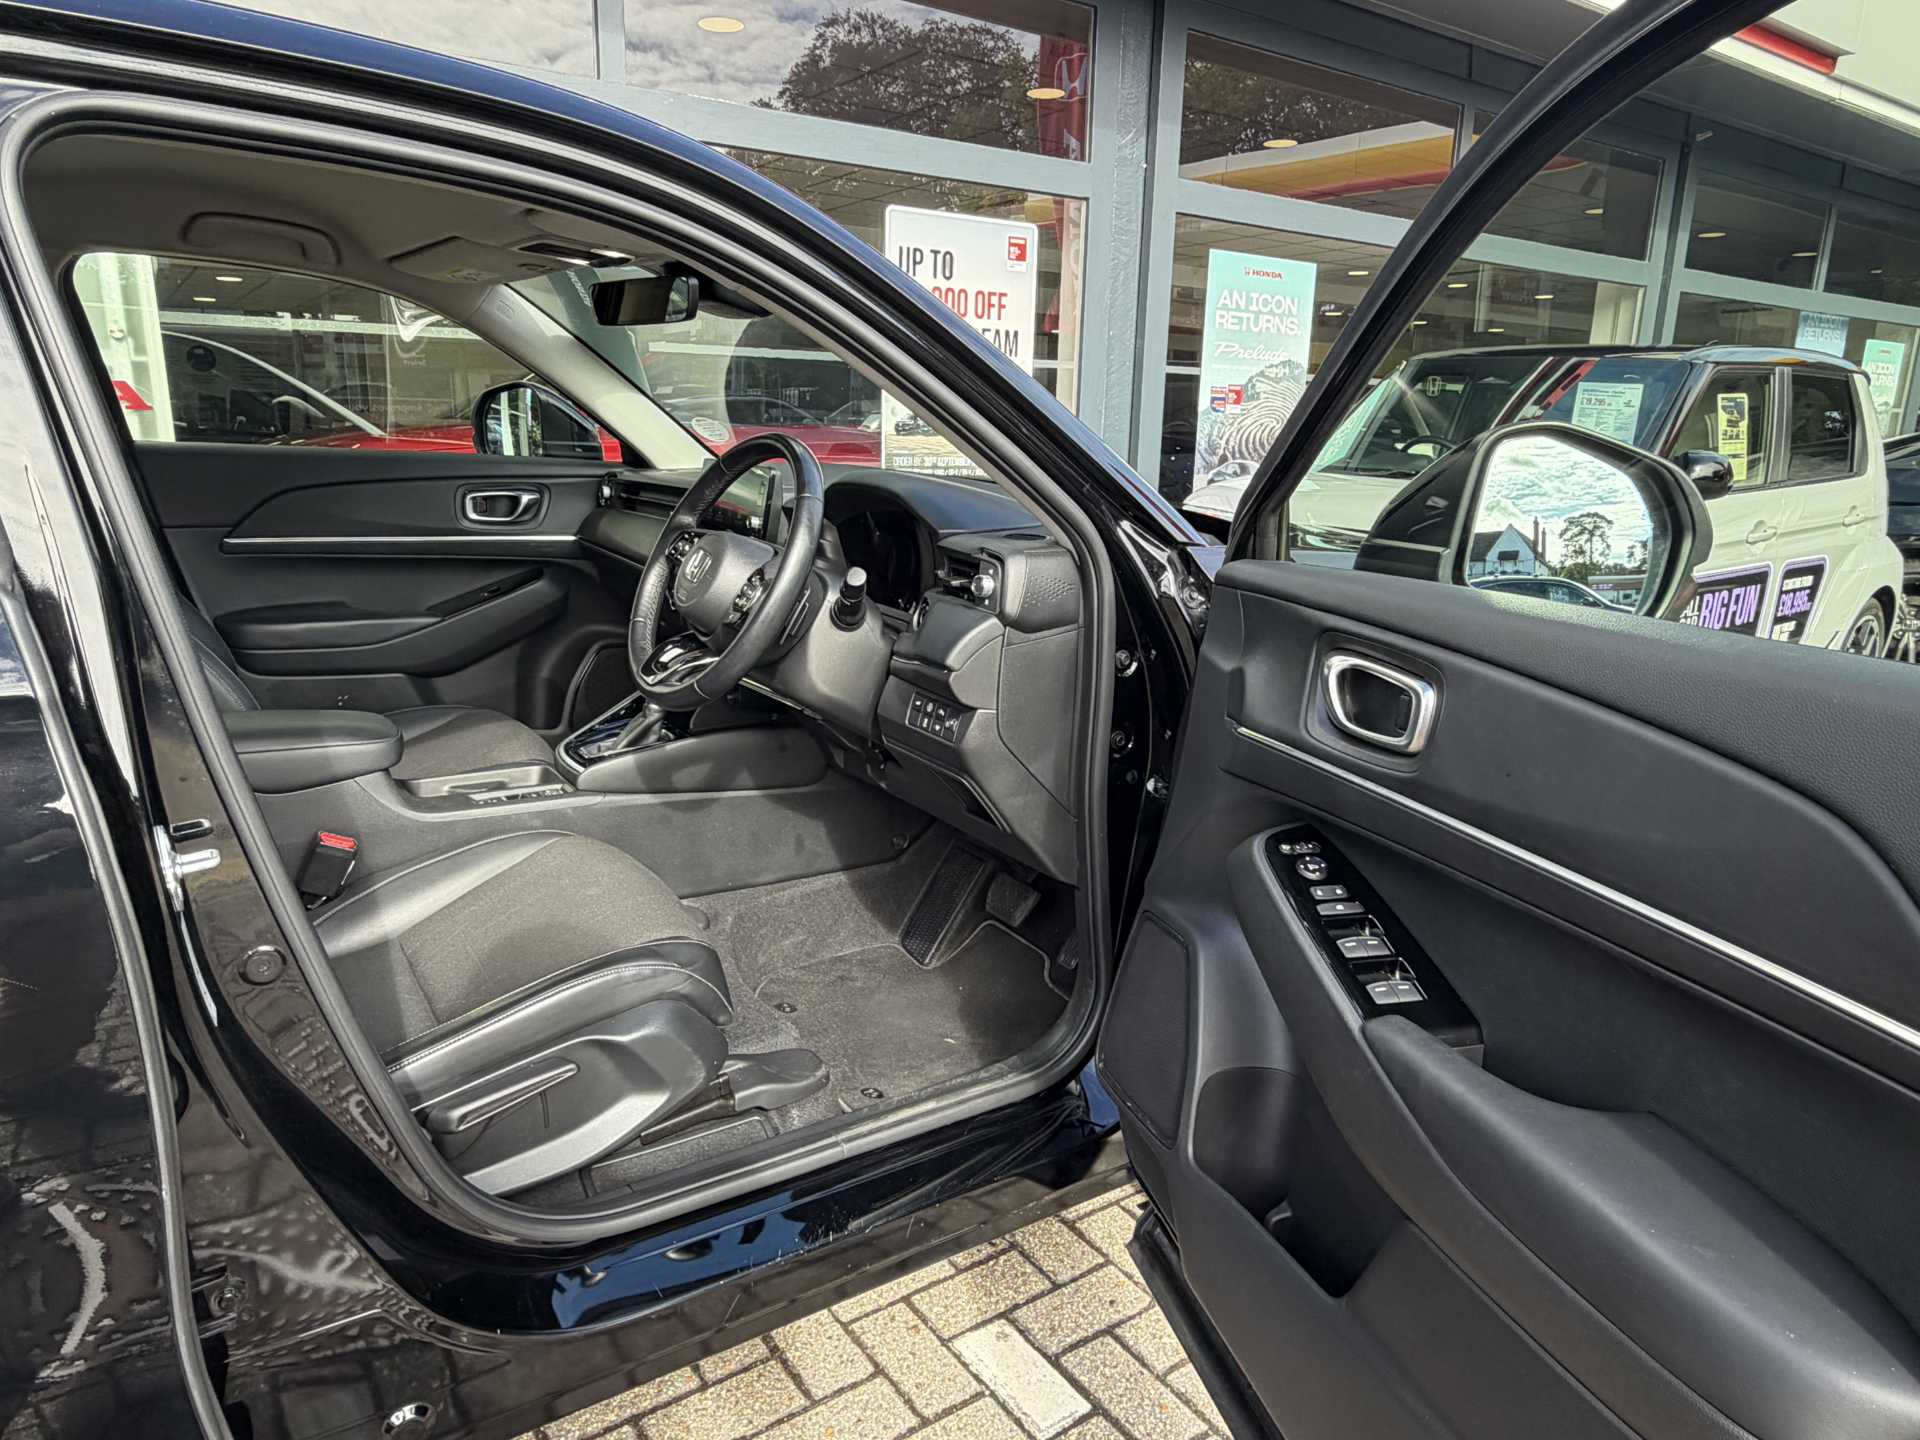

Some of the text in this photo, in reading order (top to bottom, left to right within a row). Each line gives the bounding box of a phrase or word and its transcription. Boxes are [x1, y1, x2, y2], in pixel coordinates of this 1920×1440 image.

[899, 246, 954, 281] UP TO
[1252, 269, 1283, 279] HONDA
[975, 290, 1008, 320] OFF
[1216, 289, 1298, 316] AN ICON
[1214, 310, 1301, 336] RETURNS.
[1699, 584, 1761, 630] BIG FUN
